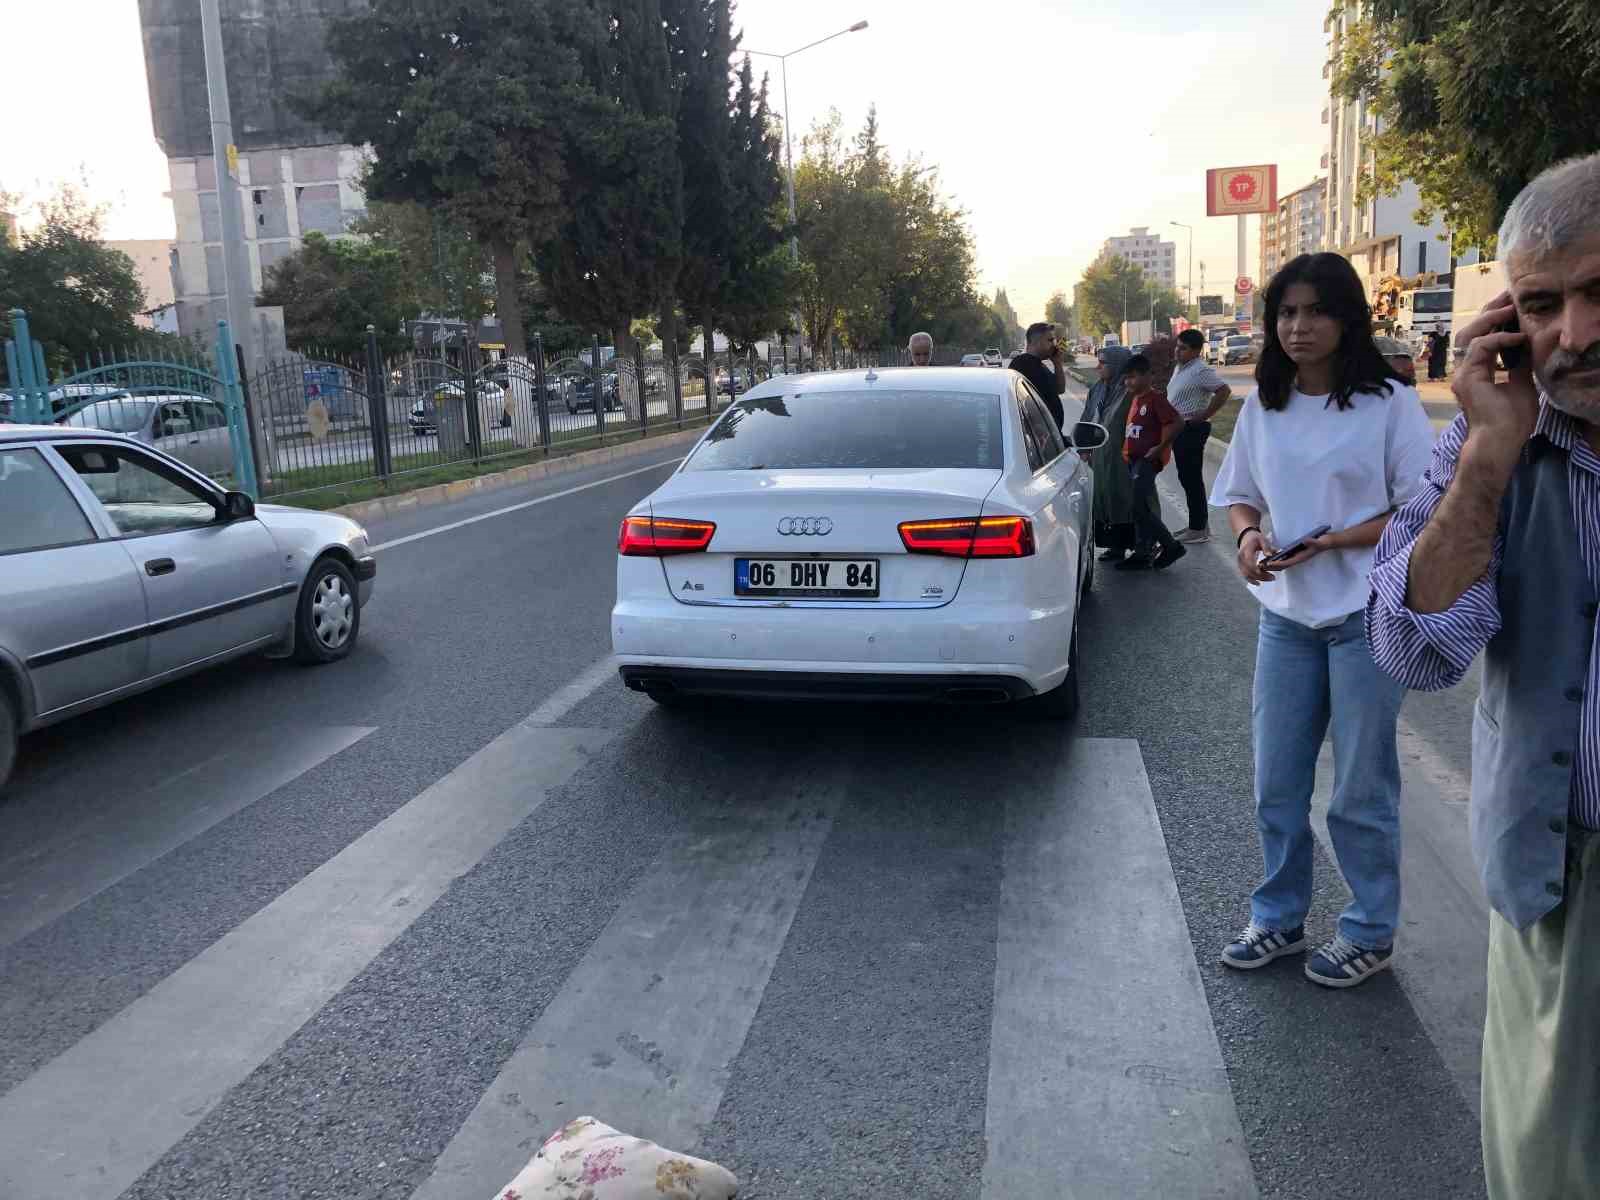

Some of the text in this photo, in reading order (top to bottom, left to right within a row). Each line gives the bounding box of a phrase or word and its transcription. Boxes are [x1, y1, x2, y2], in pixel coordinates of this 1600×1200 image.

[1235, 182, 1249, 193] TP
[750, 563, 873, 587] 06 DHY 84
